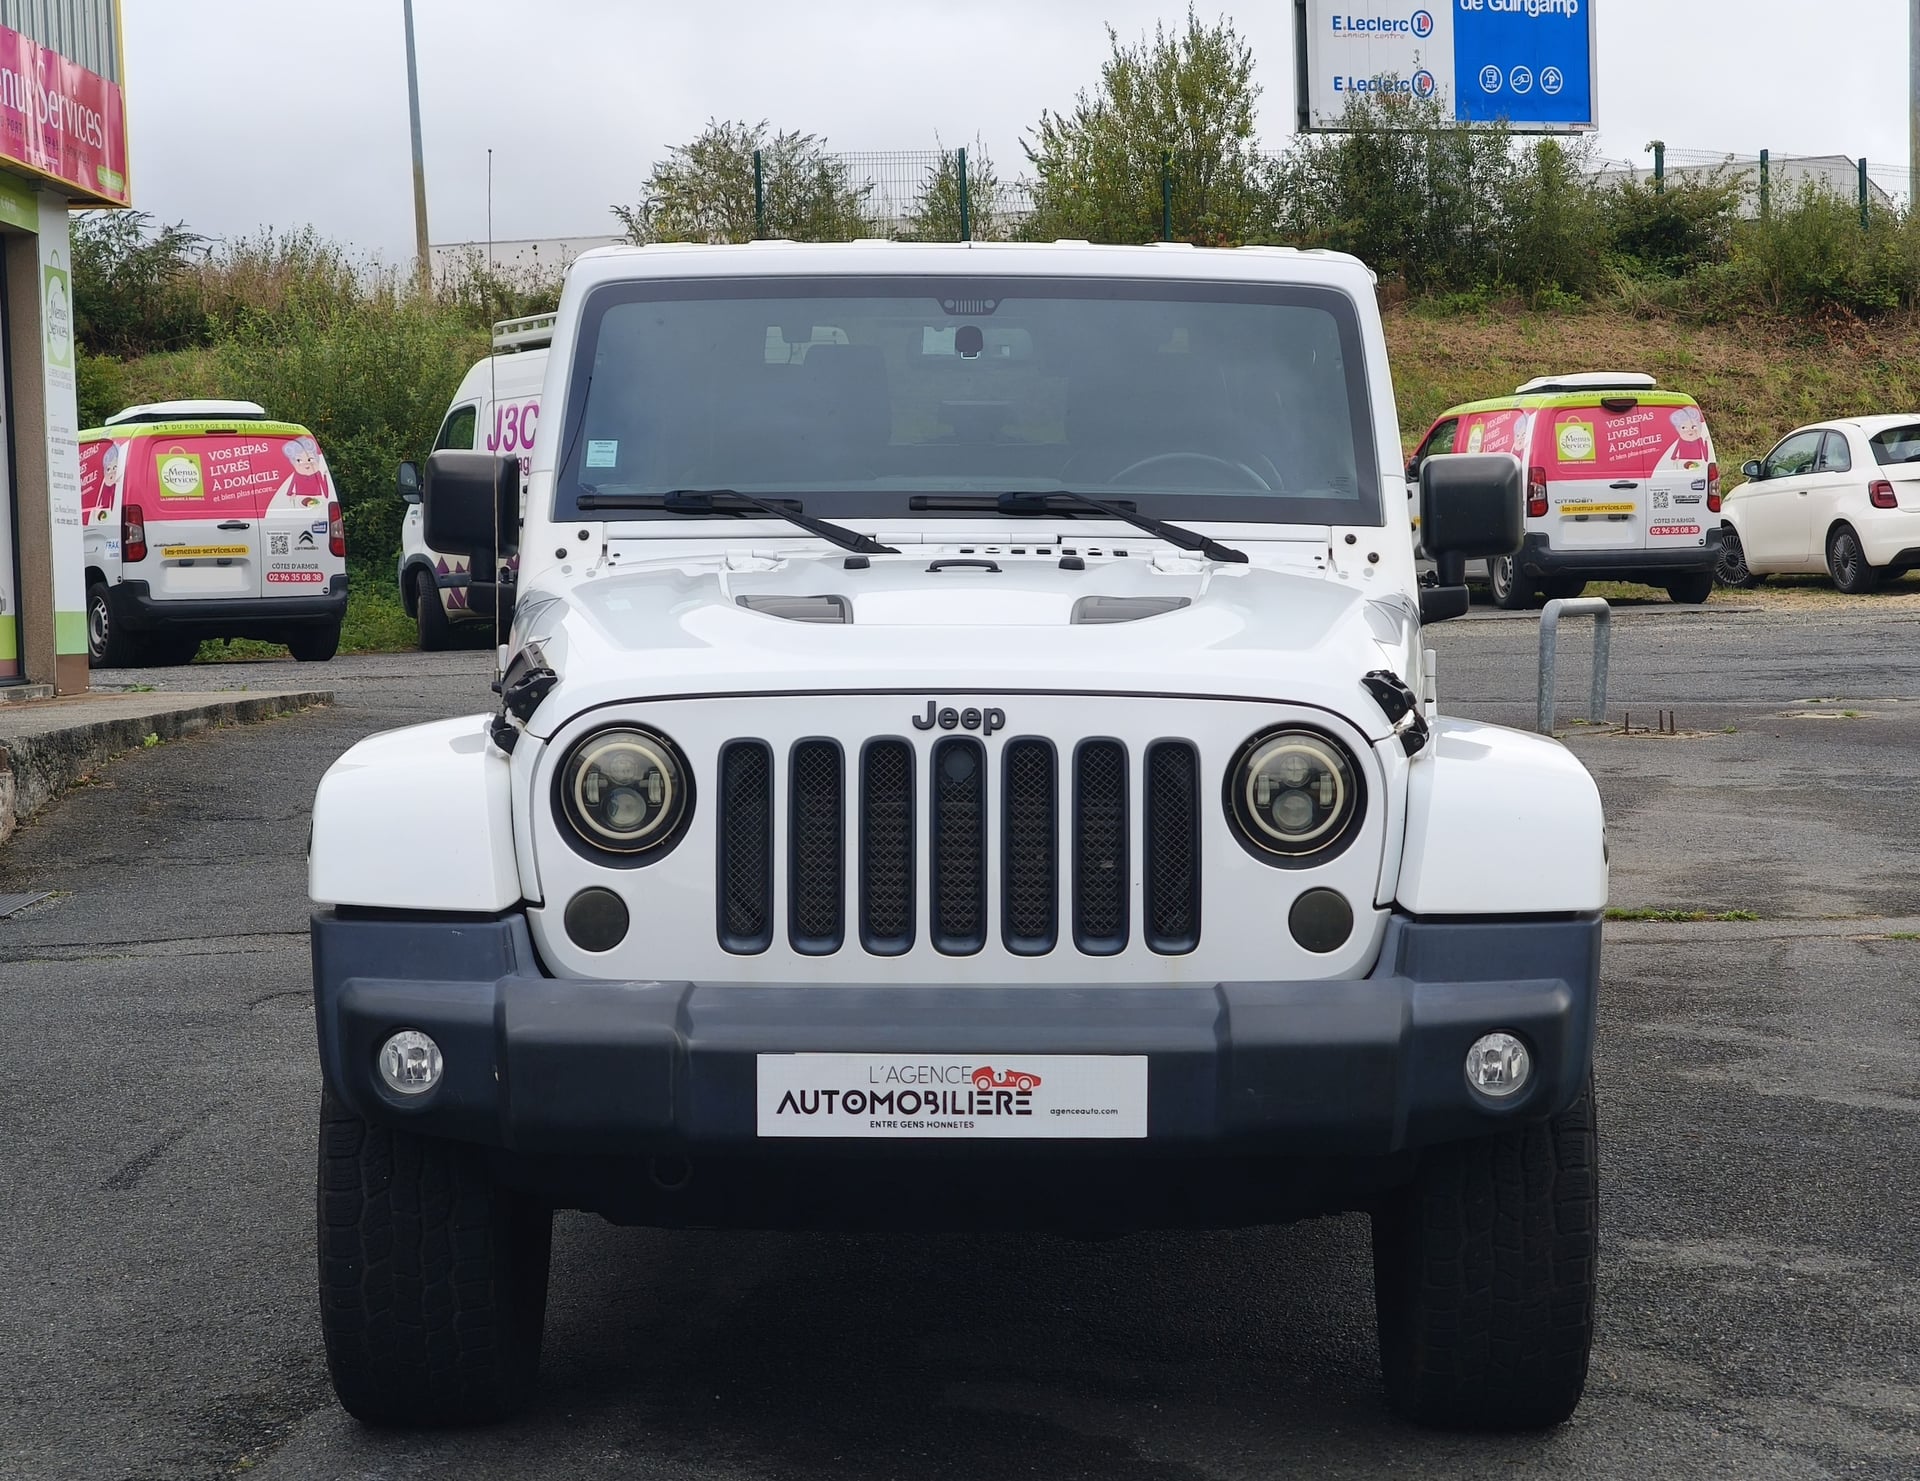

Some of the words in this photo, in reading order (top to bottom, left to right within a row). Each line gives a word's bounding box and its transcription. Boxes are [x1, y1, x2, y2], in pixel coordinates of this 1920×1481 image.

[1488, 0, 1578, 18] Guingamp
[1332, 15, 1409, 32] E.Leclerc
[36, 58, 102, 149] Services
[487, 400, 540, 452] J3C
[1606, 418, 1625, 428] VOS
[1627, 412, 1655, 425] REPAS
[1565, 434, 1591, 443] Menus
[1607, 427, 1639, 441] LIVRÉS
[1618, 434, 1662, 450] DOMICILE
[208, 449, 232, 461] VOS
[233, 443, 269, 458] REPAS
[1561, 442, 1591, 450] Services
[167, 468, 198, 476] Menus
[210, 460, 250, 476] LIVRÉS
[163, 475, 198, 483] Services
[212, 478, 222, 491] À
[223, 470, 280, 490] DOMICILE
[164, 547, 247, 556] les-menus-services.com
[271, 562, 291, 570] CÔTES
[268, 573, 279, 581] 02
[280, 573, 290, 581] 96
[291, 573, 301, 581] 35
[301, 573, 311, 581] 08
[312, 573, 322, 581] 38
[912, 700, 1006, 736] Jeep
[869, 1064, 973, 1084] L'AGENCE
[1050, 1107, 1119, 1117] agenceauto.com
[869, 1119, 899, 1129] ENTRE
[900, 1120, 925, 1129] GENS
[926, 1120, 975, 1129] HONNETES
